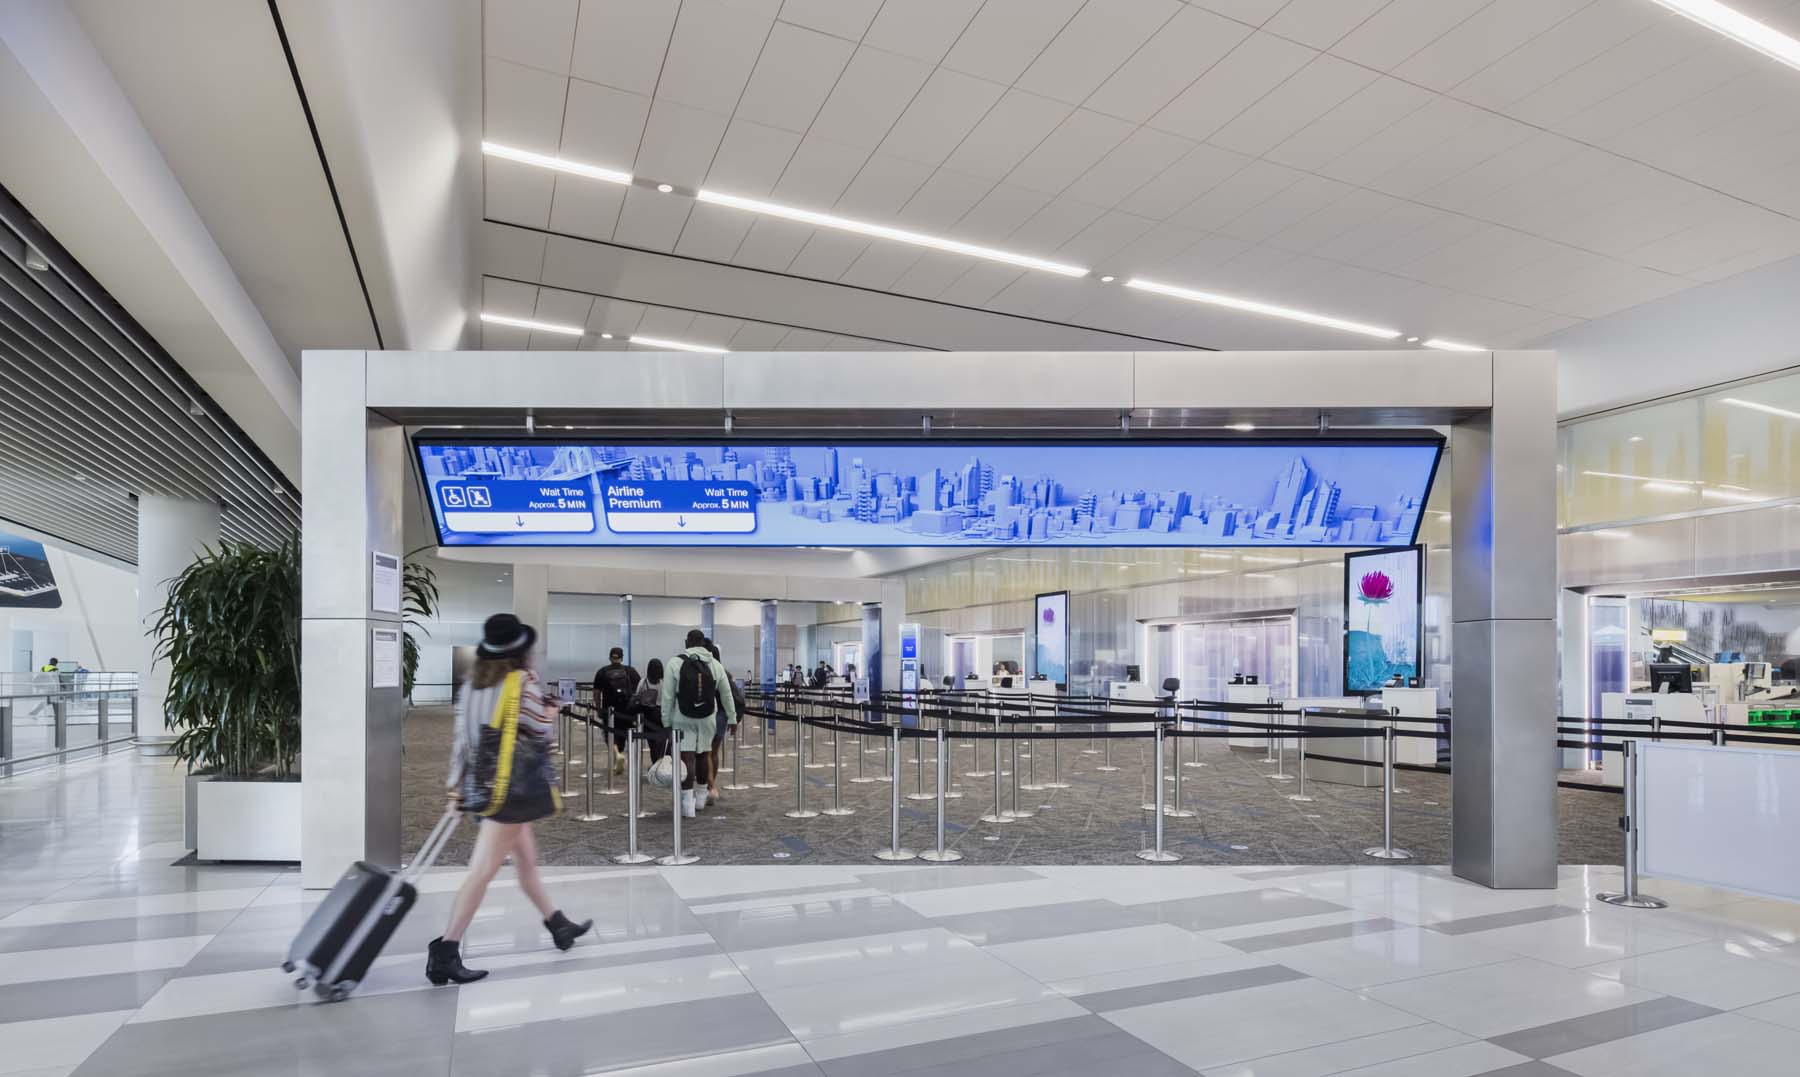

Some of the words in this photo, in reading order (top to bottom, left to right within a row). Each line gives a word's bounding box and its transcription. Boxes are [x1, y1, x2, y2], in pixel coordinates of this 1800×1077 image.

[539, 487, 560, 497] Wait
[561, 487, 584, 497] Time
[608, 486, 644, 497] Airline
[704, 487, 725, 497] Wait
[726, 487, 749, 497] Time
[529, 501, 558, 510] Approx.
[558, 498, 567, 509] 5
[567, 500, 586, 509] MIN
[609, 498, 662, 509] Premium
[692, 501, 721, 510] Approx.
[721, 498, 730, 509] 5
[730, 500, 749, 510] MIN
